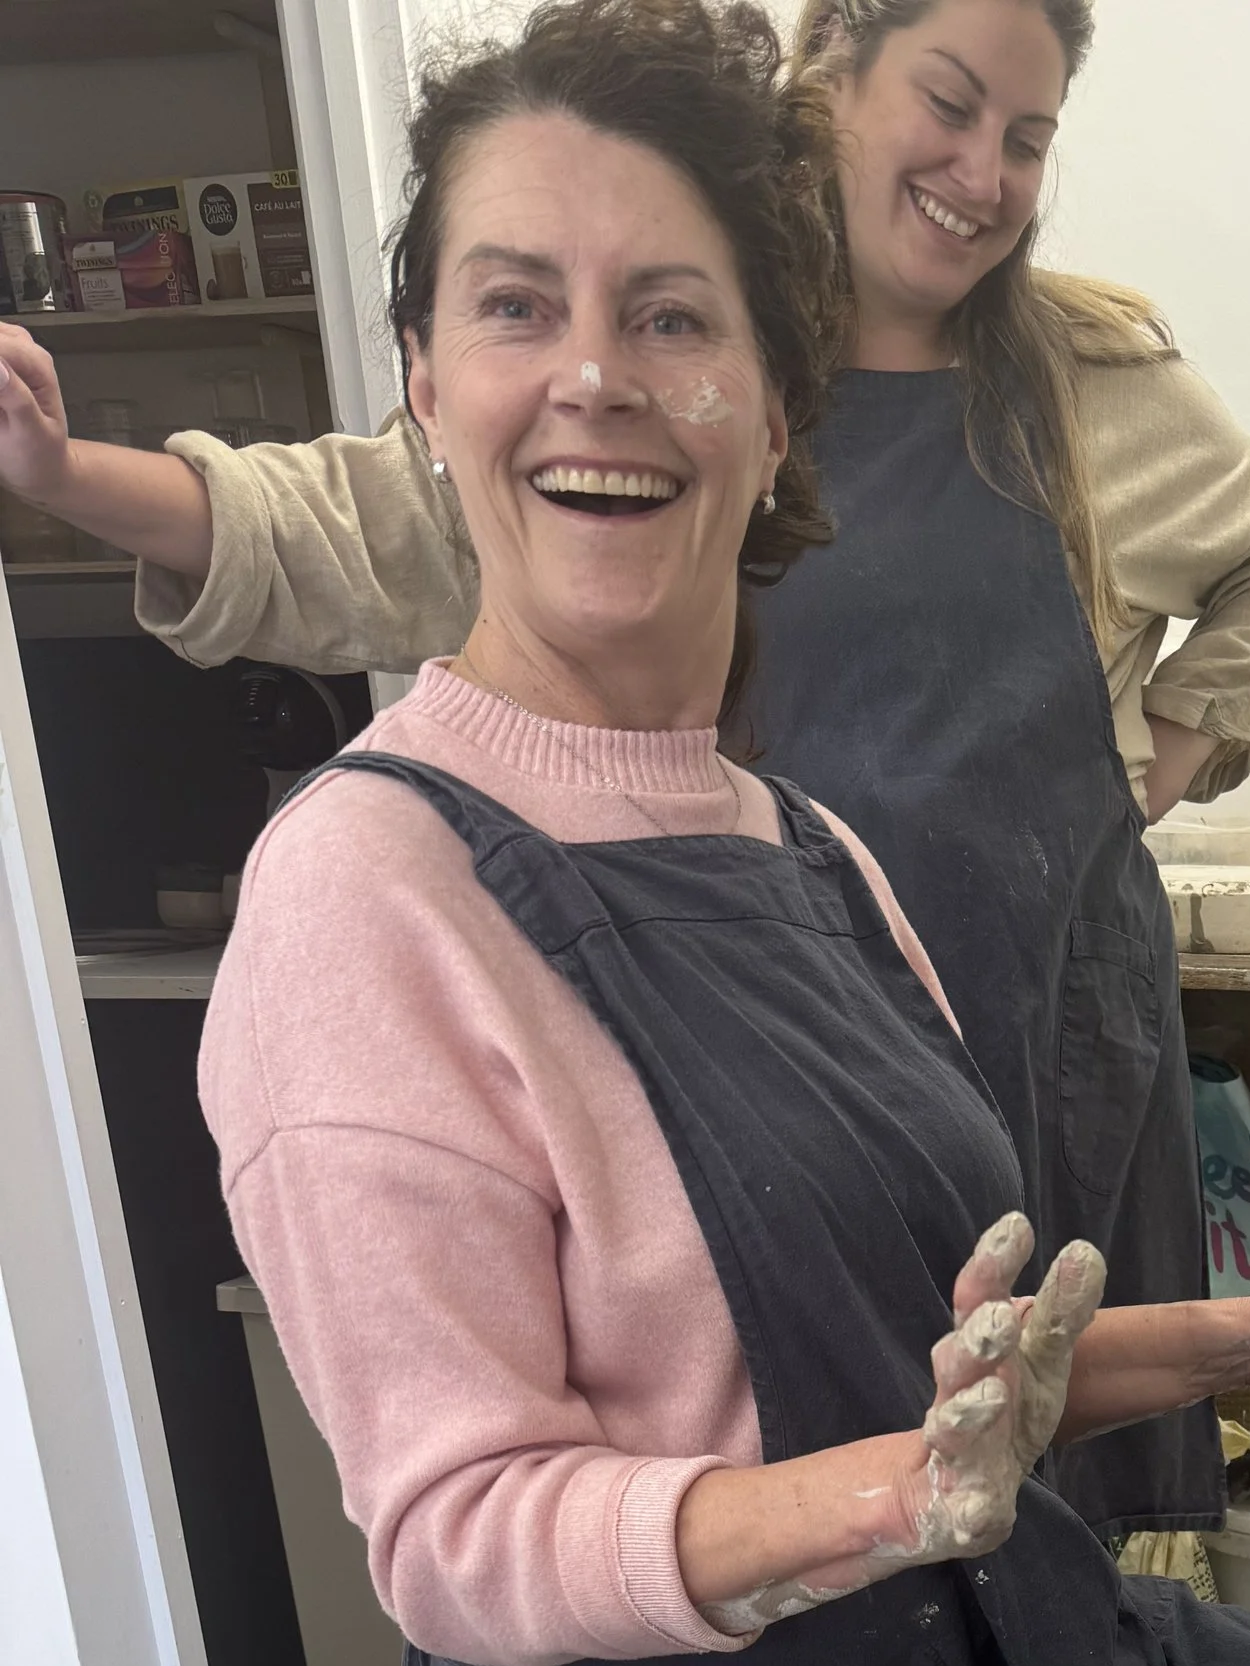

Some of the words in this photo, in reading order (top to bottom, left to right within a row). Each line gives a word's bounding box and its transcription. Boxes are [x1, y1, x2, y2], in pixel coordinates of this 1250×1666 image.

[274, 173, 287, 186] 30
[203, 202, 231, 214] Dolce
[205, 211, 233, 224] Gusto
[75, 258, 113, 268] TWININGS
[81, 277, 109, 289] Fruits
